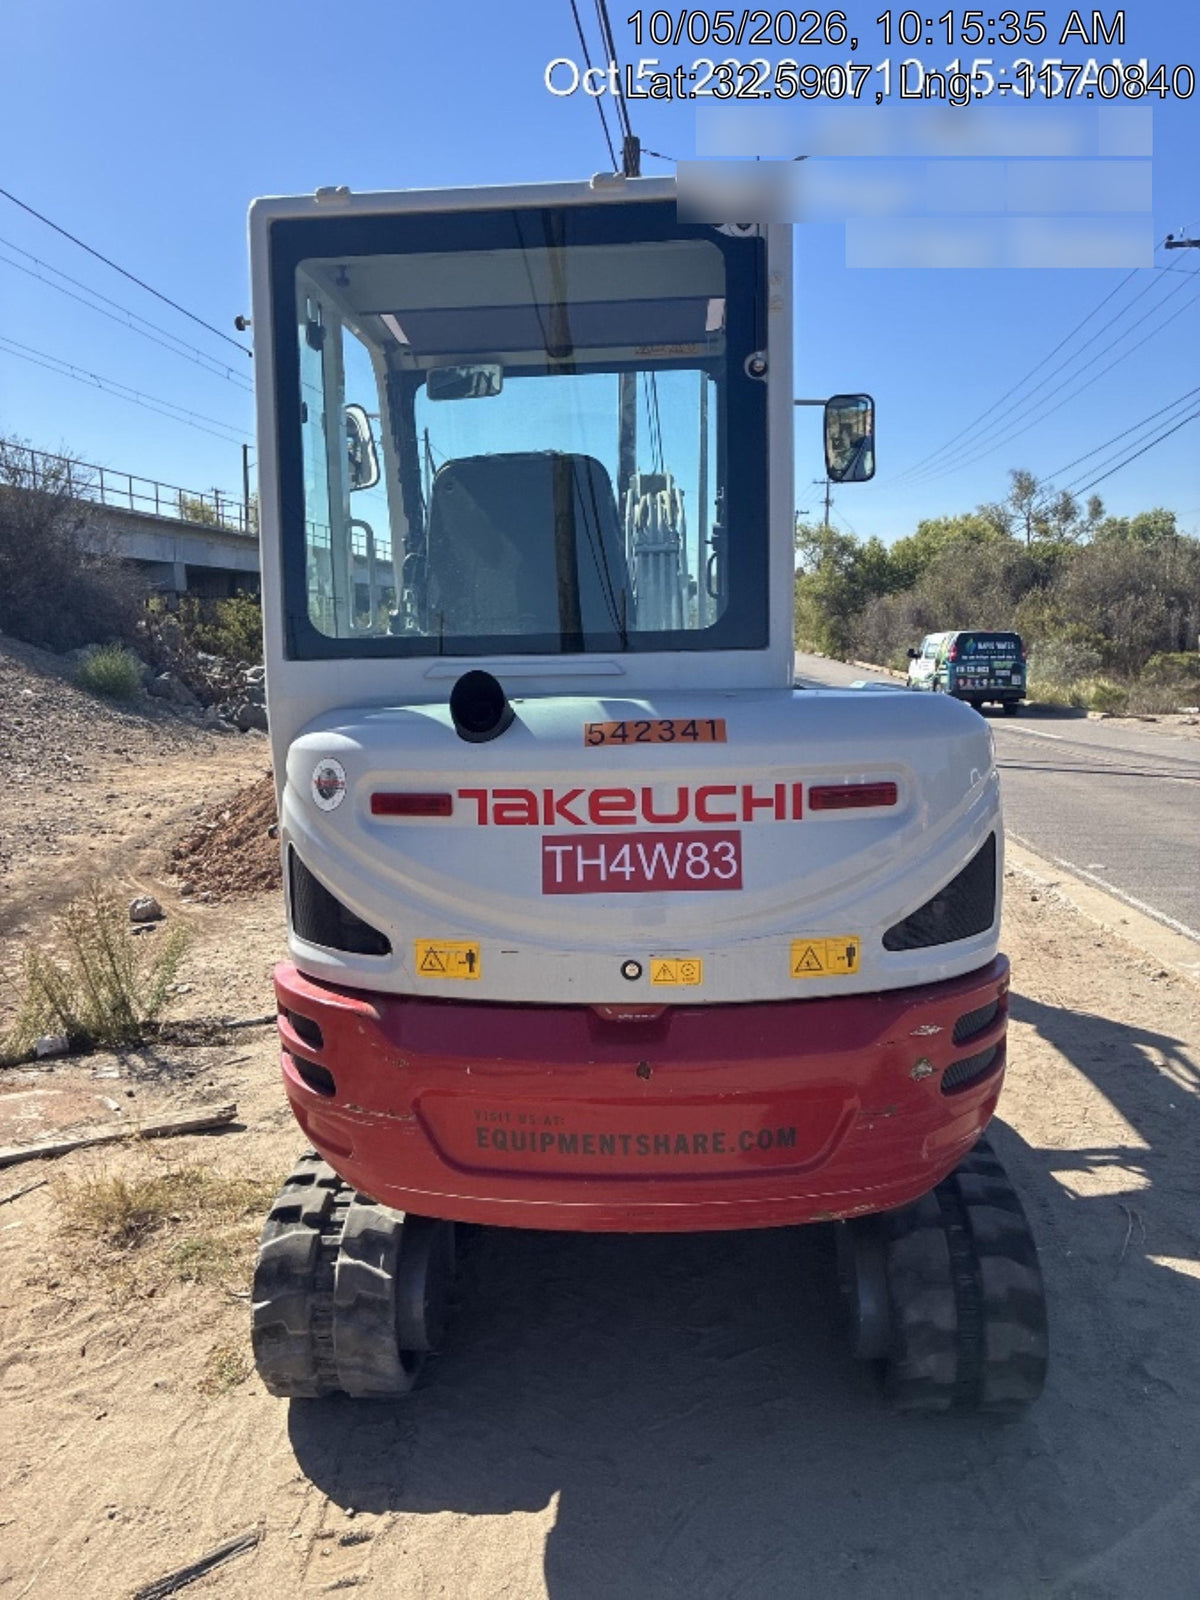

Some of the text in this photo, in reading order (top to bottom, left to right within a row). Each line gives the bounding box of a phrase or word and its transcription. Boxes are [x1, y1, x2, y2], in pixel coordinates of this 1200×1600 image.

[587, 718, 717, 746] 542341
[544, 840, 738, 883] TH4W83
[474, 1108, 511, 1123] VISIT
[518, 1113, 536, 1125] US
[476, 1126, 797, 1157] EQUIPMENTSHARE.COM
